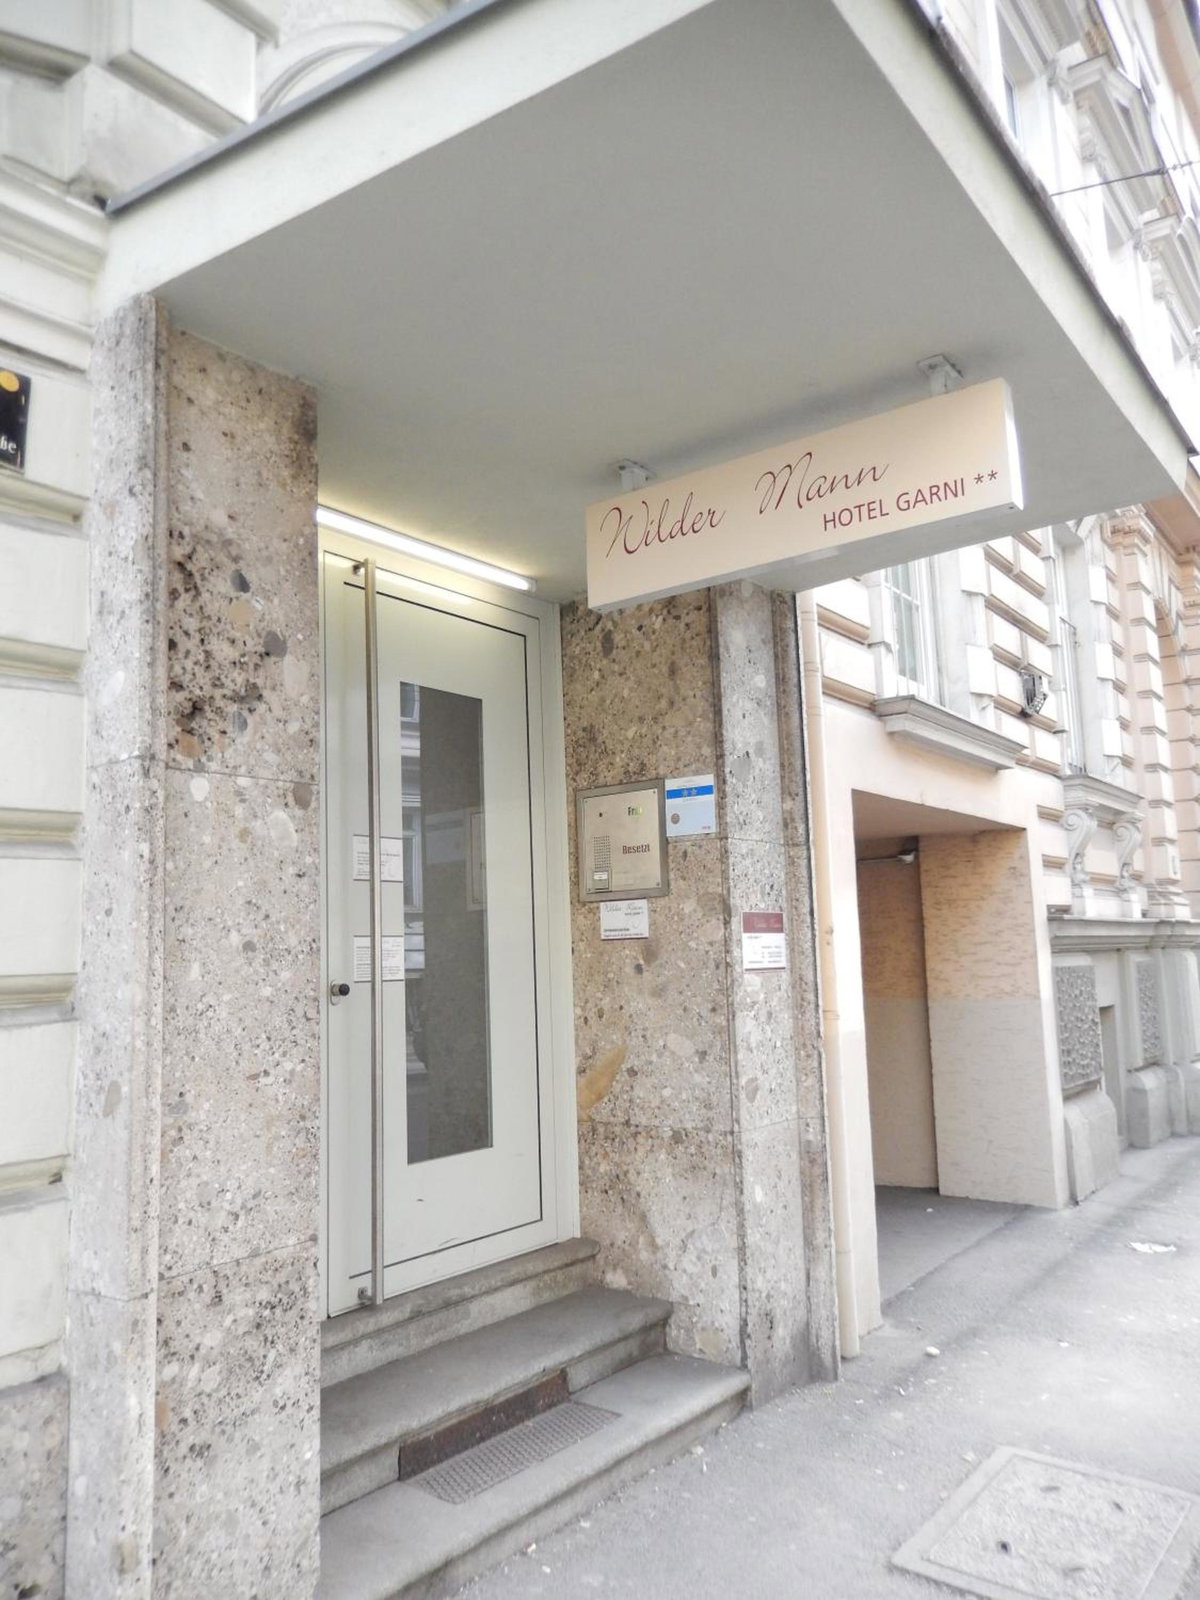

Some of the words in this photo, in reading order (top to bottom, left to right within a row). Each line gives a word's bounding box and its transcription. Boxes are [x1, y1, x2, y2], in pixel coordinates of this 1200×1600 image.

[599, 493, 726, 559] Wilder
[754, 451, 890, 514] Mann
[823, 501, 889, 532] HOTEL
[896, 477, 967, 513] GARNI
